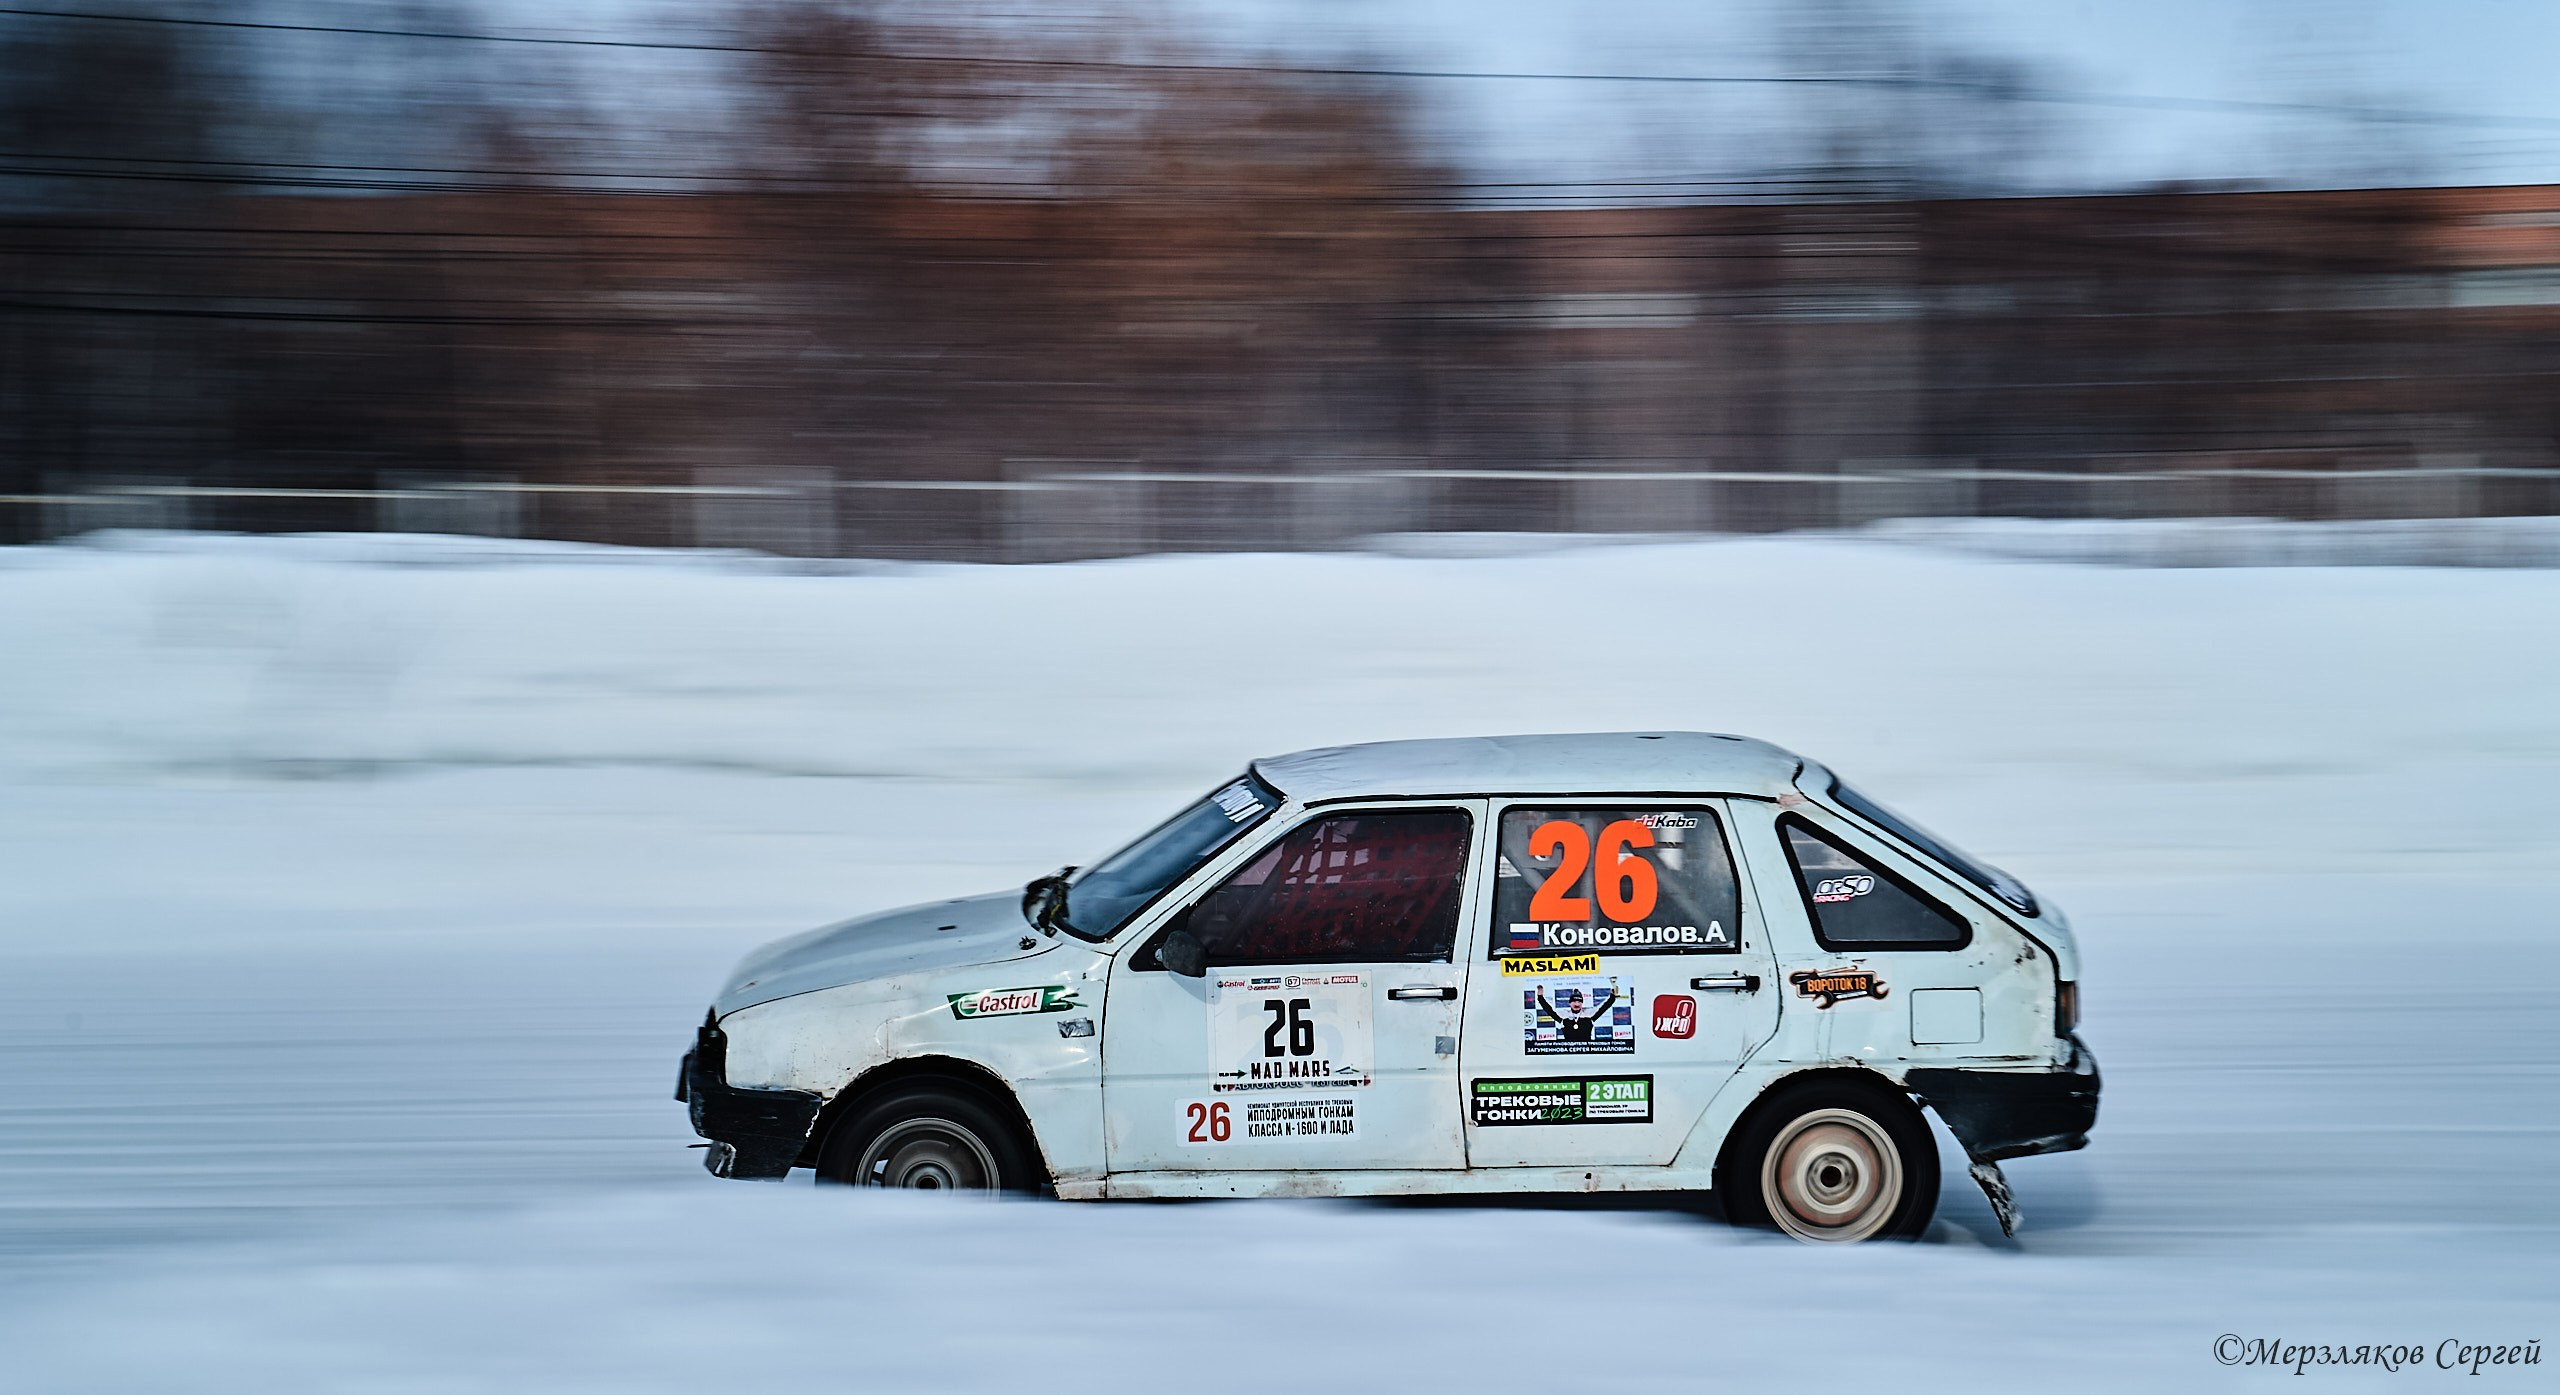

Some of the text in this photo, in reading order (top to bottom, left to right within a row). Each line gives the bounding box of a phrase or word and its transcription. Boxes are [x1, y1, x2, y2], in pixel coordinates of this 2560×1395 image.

[1528, 820, 1658, 923] 26
[1543, 920, 1727, 946] Коновалов.А
[1504, 956, 1596, 973] MASLAMI
[1332, 976, 1358, 984] MOTUL
[1807, 976, 1867, 992] ВОРОТОК 18
[979, 992, 1037, 1013] Castrol
[1263, 998, 1315, 1058] 26
[1250, 1060, 1330, 1080] MAD MARS
[1590, 1083, 1646, 1099] 2 ЭТАП
[1476, 1094, 1582, 1108] ТРЕКОВЫЕ
[1247, 1106, 1354, 1122] ИППОДРОМНЫМ ГОНКАМ
[1477, 1106, 1583, 1121] ГОНКИ 2023
[1187, 1102, 1231, 1143] 26
[1248, 1120, 1354, 1138] КЛАССА N-1600 И ЛАДА
